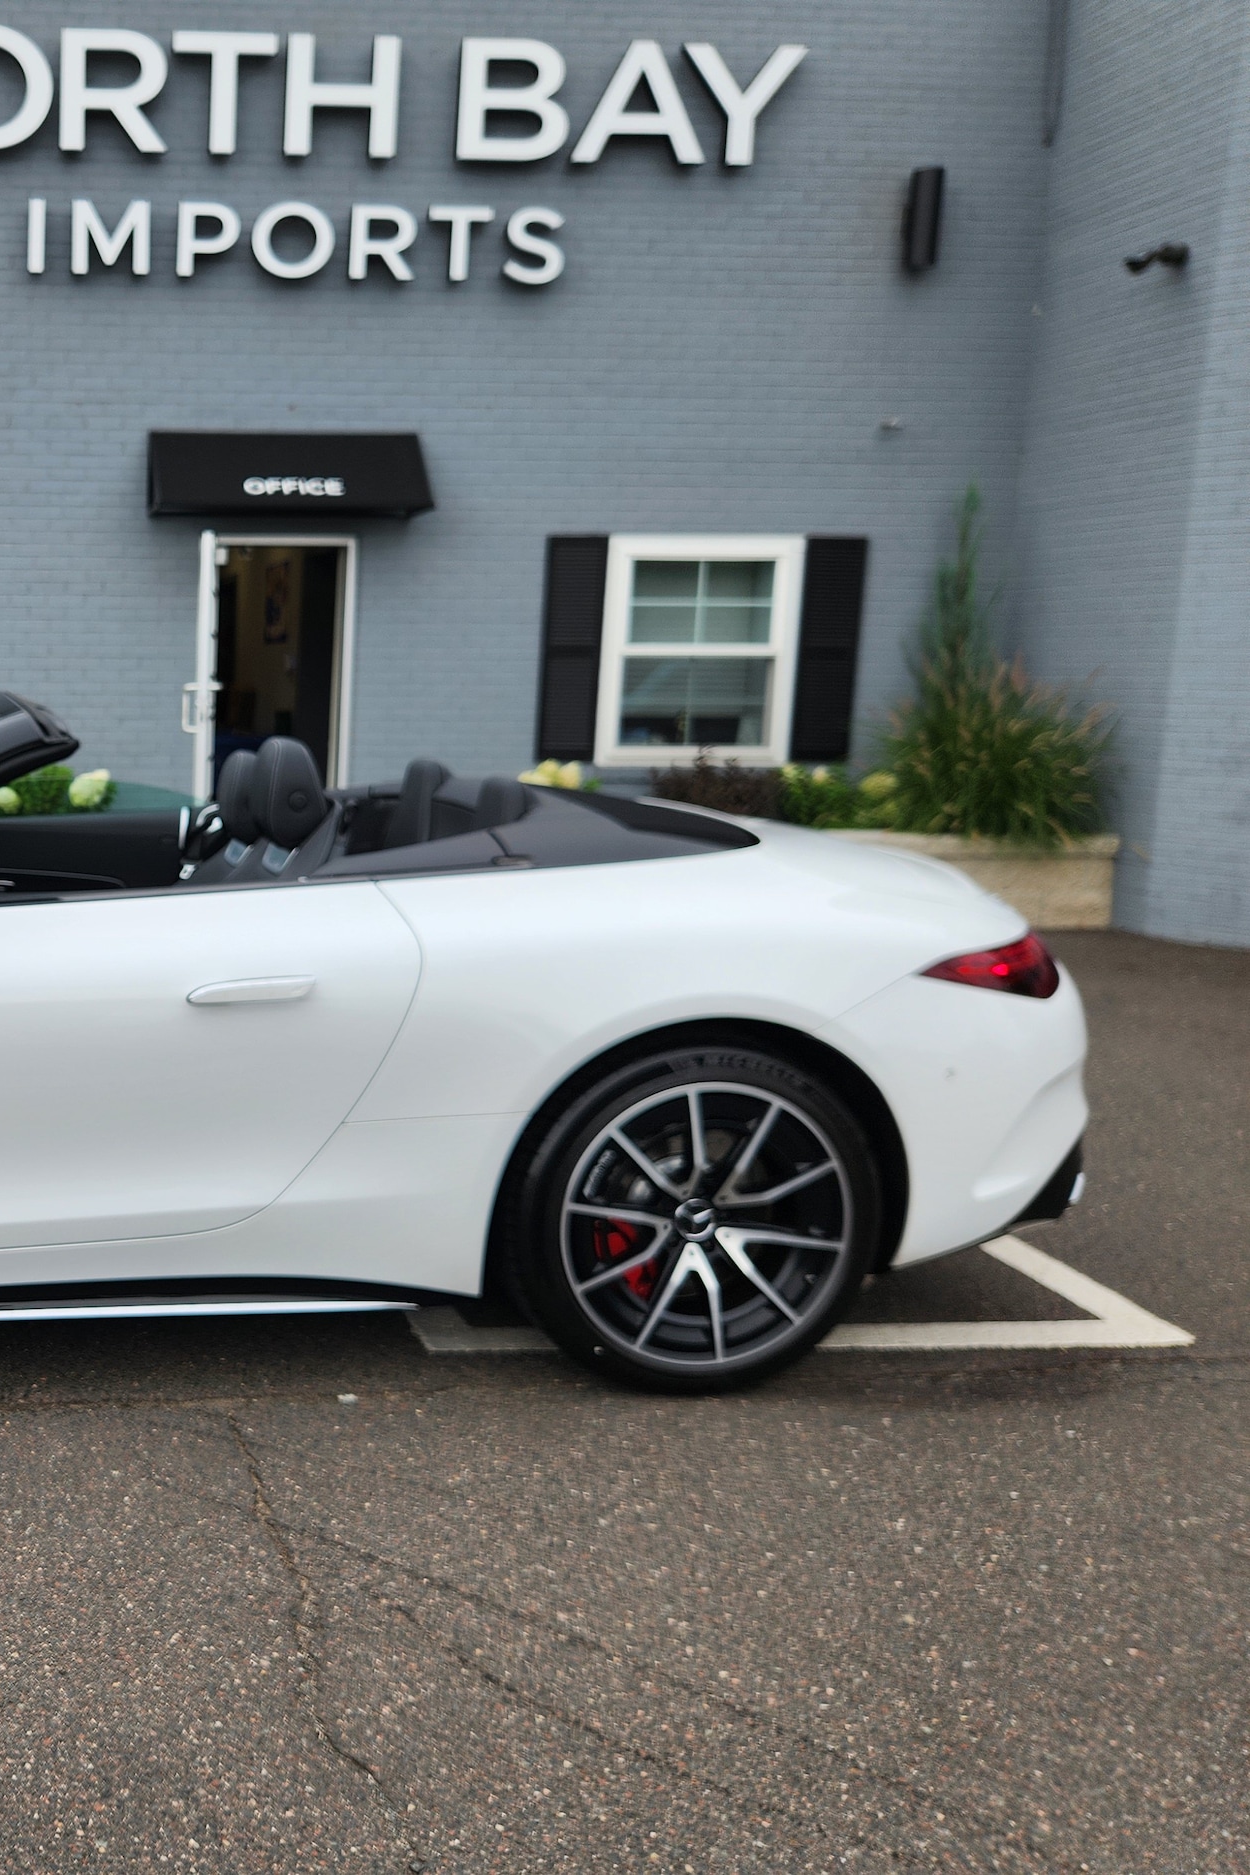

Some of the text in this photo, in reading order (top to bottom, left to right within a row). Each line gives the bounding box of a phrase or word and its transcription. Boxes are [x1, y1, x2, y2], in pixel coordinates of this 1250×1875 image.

[455, 38, 809, 166] BAY
[26, 197, 566, 285] IMPORTS
[243, 476, 346, 497] OFFICE
